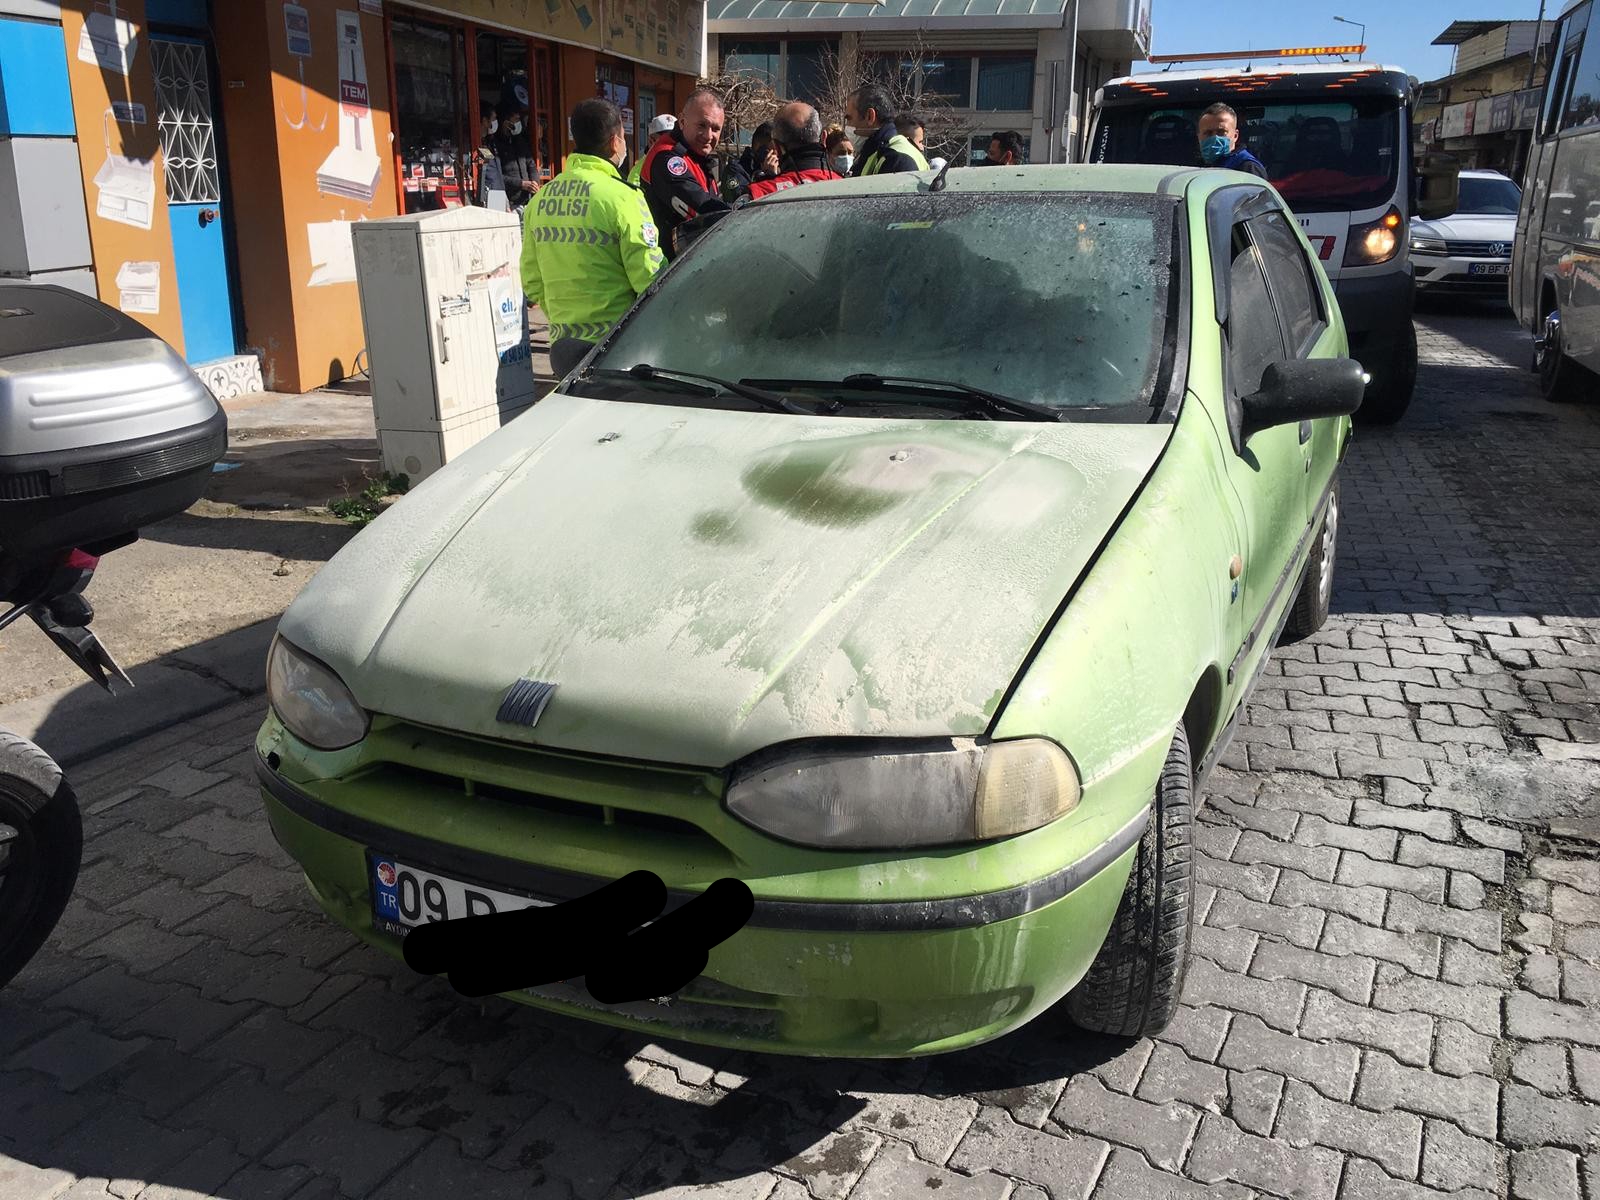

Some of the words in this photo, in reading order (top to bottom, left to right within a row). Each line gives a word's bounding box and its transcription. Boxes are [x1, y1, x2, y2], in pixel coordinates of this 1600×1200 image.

[342, 84, 366, 100] TEM
[1475, 264, 1486, 273] 09
[381, 891, 397, 909] TR
[398, 871, 448, 923] 09
